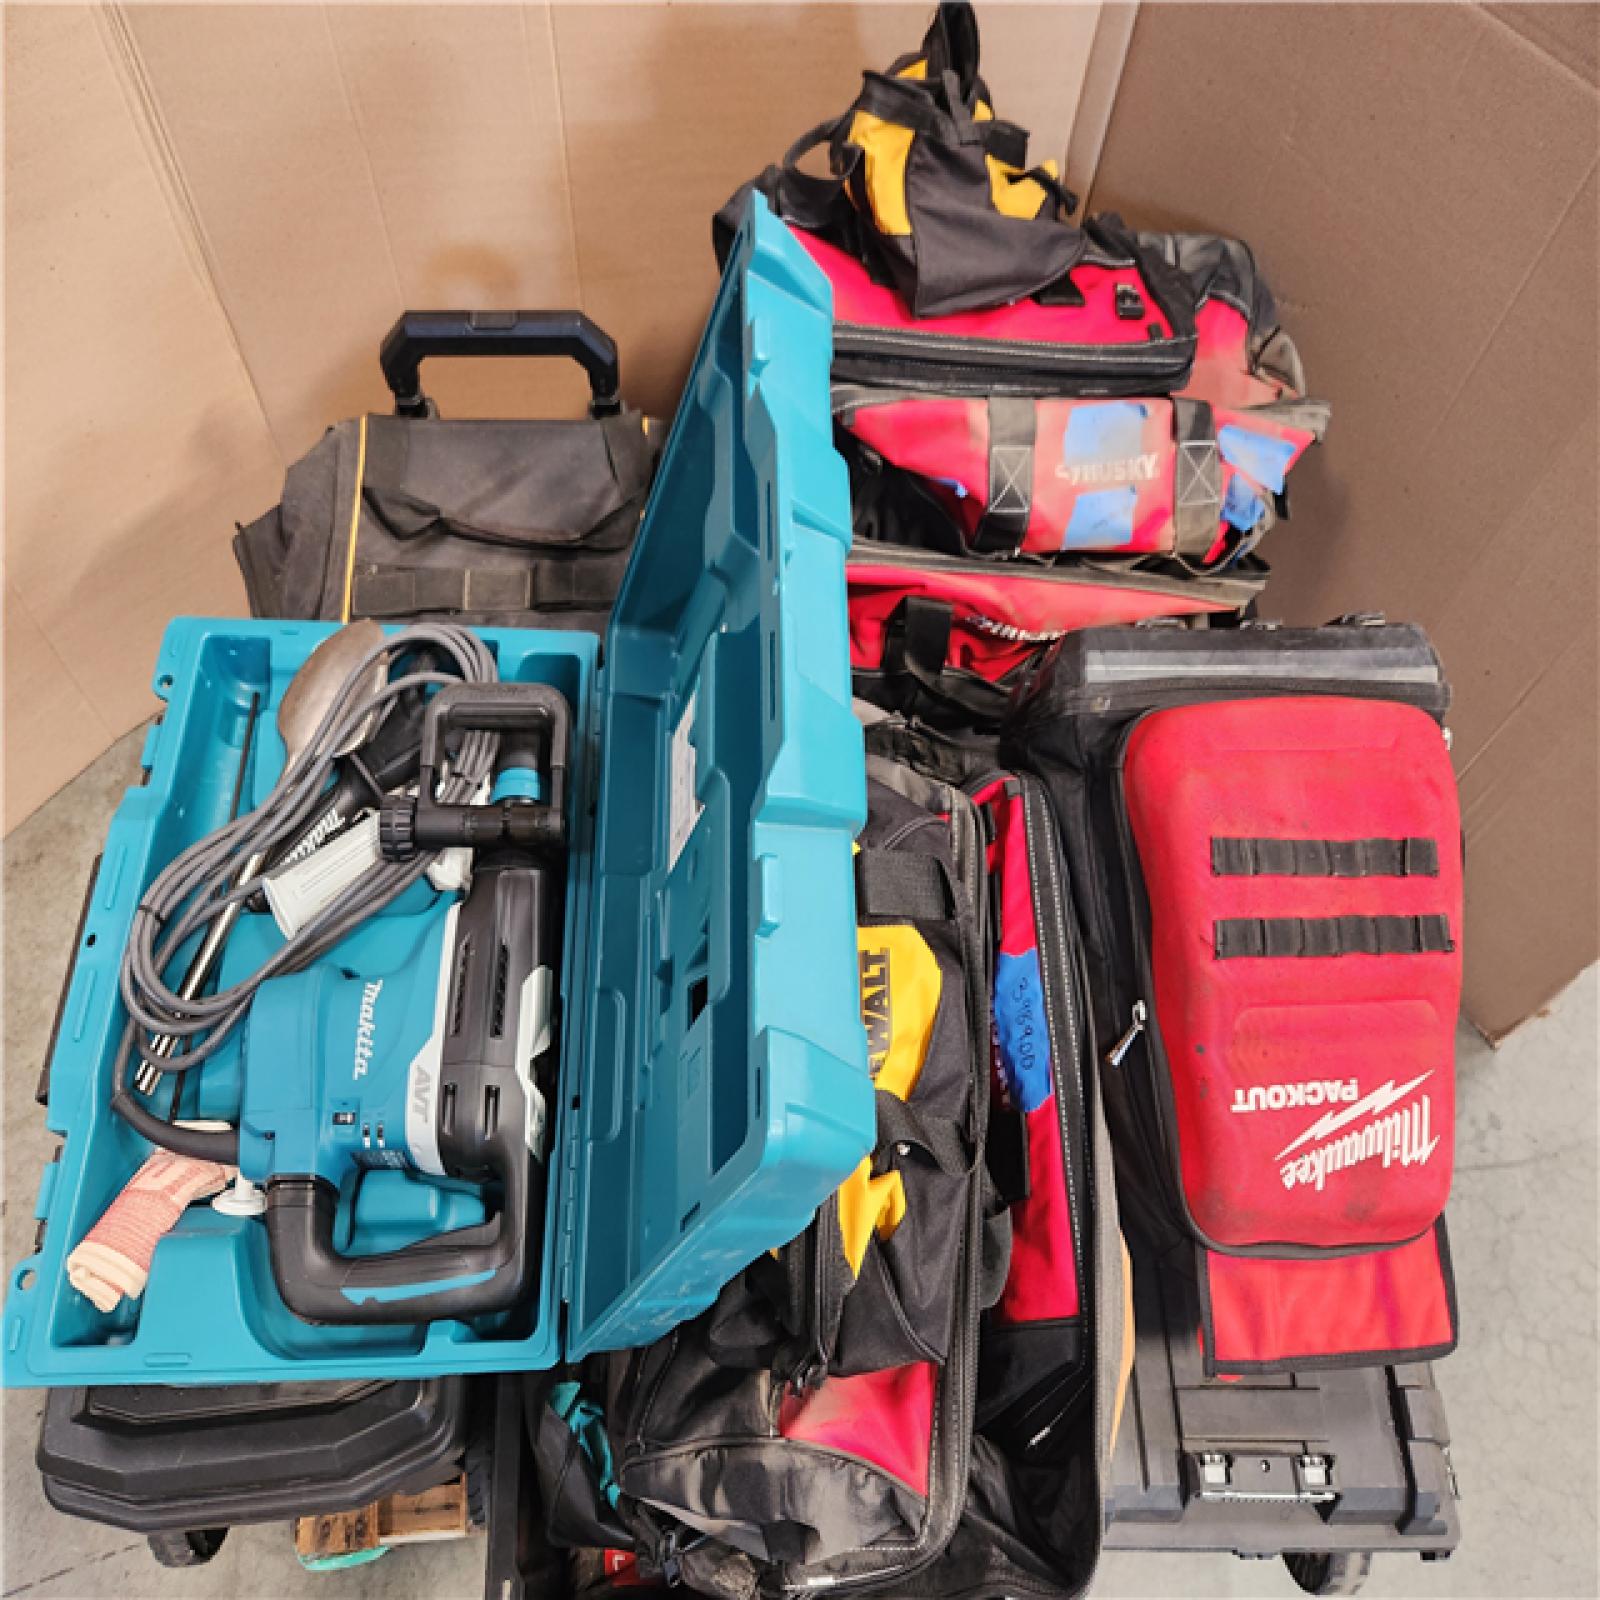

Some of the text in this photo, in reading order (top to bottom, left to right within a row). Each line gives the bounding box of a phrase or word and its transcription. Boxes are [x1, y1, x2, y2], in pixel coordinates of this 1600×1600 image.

[414, 1065, 432, 1124] AVT
[1230, 1077, 1359, 1113] PACKOUT
[1280, 1094, 1441, 1191] Milwaukee
